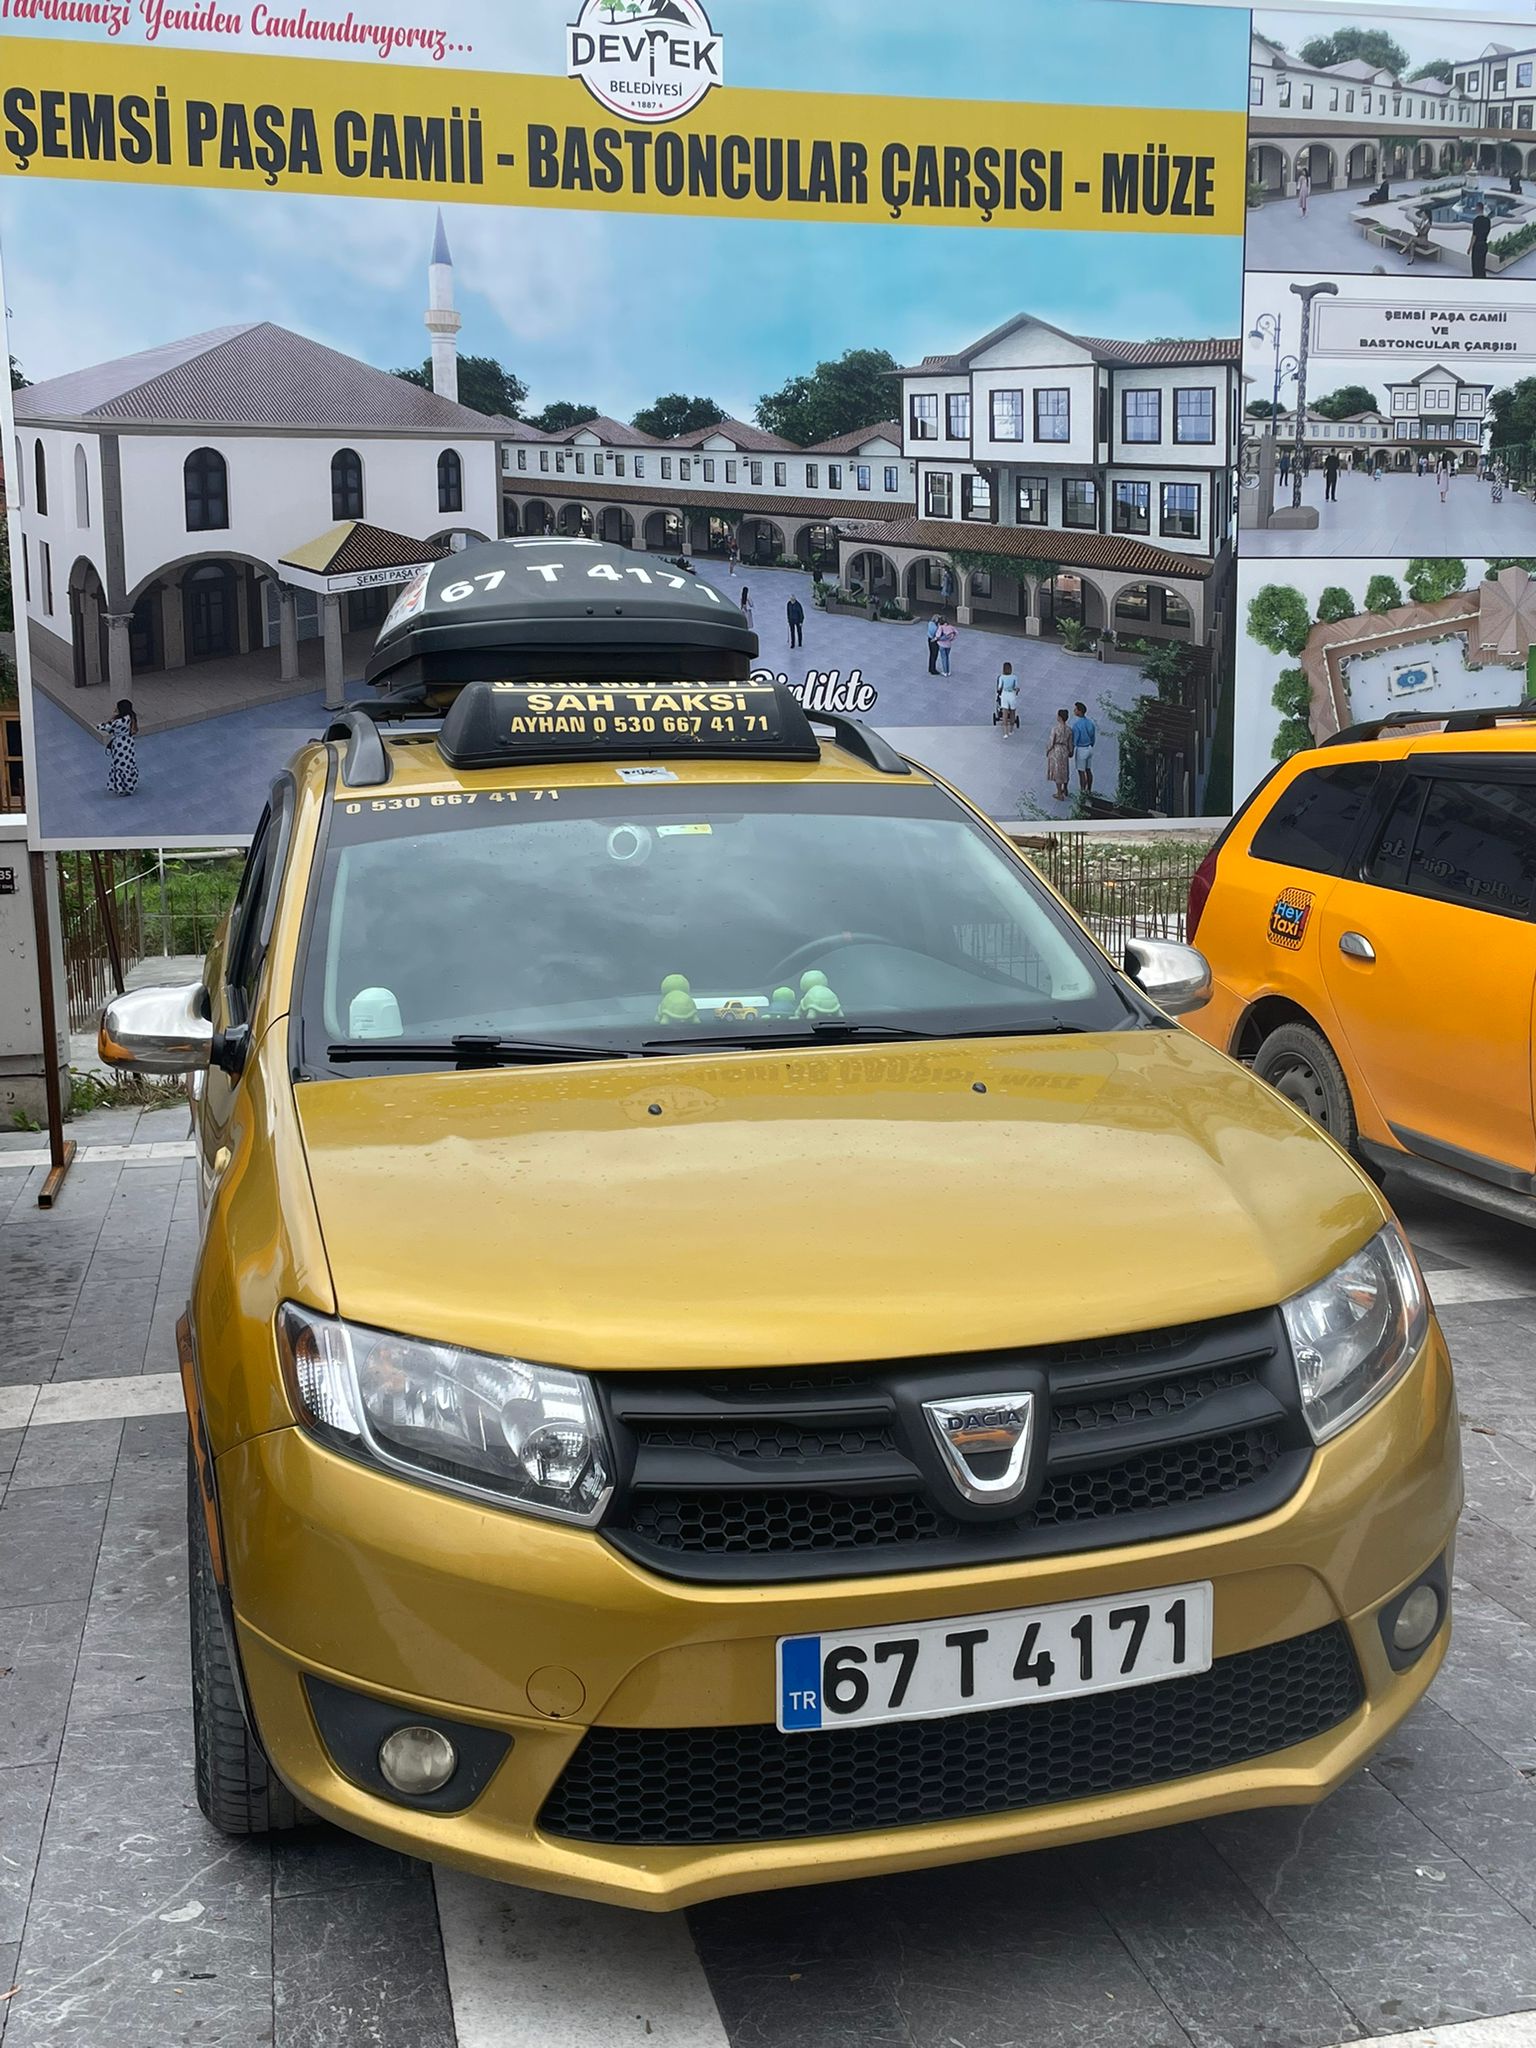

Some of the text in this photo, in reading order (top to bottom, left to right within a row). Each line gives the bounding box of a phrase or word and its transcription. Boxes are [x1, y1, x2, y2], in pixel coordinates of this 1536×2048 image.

[140, 2, 242, 41] Yeniden
[610, 80, 682, 96] BELEDİYESİ
[3, 86, 171, 170] ŞEMSİ
[186, 100, 322, 186] PAŞA
[334, 106, 483, 184] CAMİİ
[527, 123, 868, 204] BASTONCULAR
[882, 143, 1063, 222] ÇARŞISI
[1102, 143, 1215, 216] MÜZE
[1385, 310, 1507, 322] ŞEMSİ PAŞA CAMİİ
[1431, 326, 1449, 335] VE
[1359, 339, 1517, 352] BASTONCULAR ÇARŞISI
[440, 570, 506, 602] 67
[526, 564, 564, 582] T
[586, 563, 721, 603] 4171
[527, 693, 615, 714] ŞAH
[511, 715, 769, 733] AYHAN 0 530 667 41 71
[346, 790, 560, 814] 0 530 667 41 71
[1276, 901, 1304, 924] Hey
[1272, 914, 1300, 936] Taxi
[948, 1411, 1021, 1430] DACIA
[789, 1599, 1186, 1714] TR 67 T 4171
